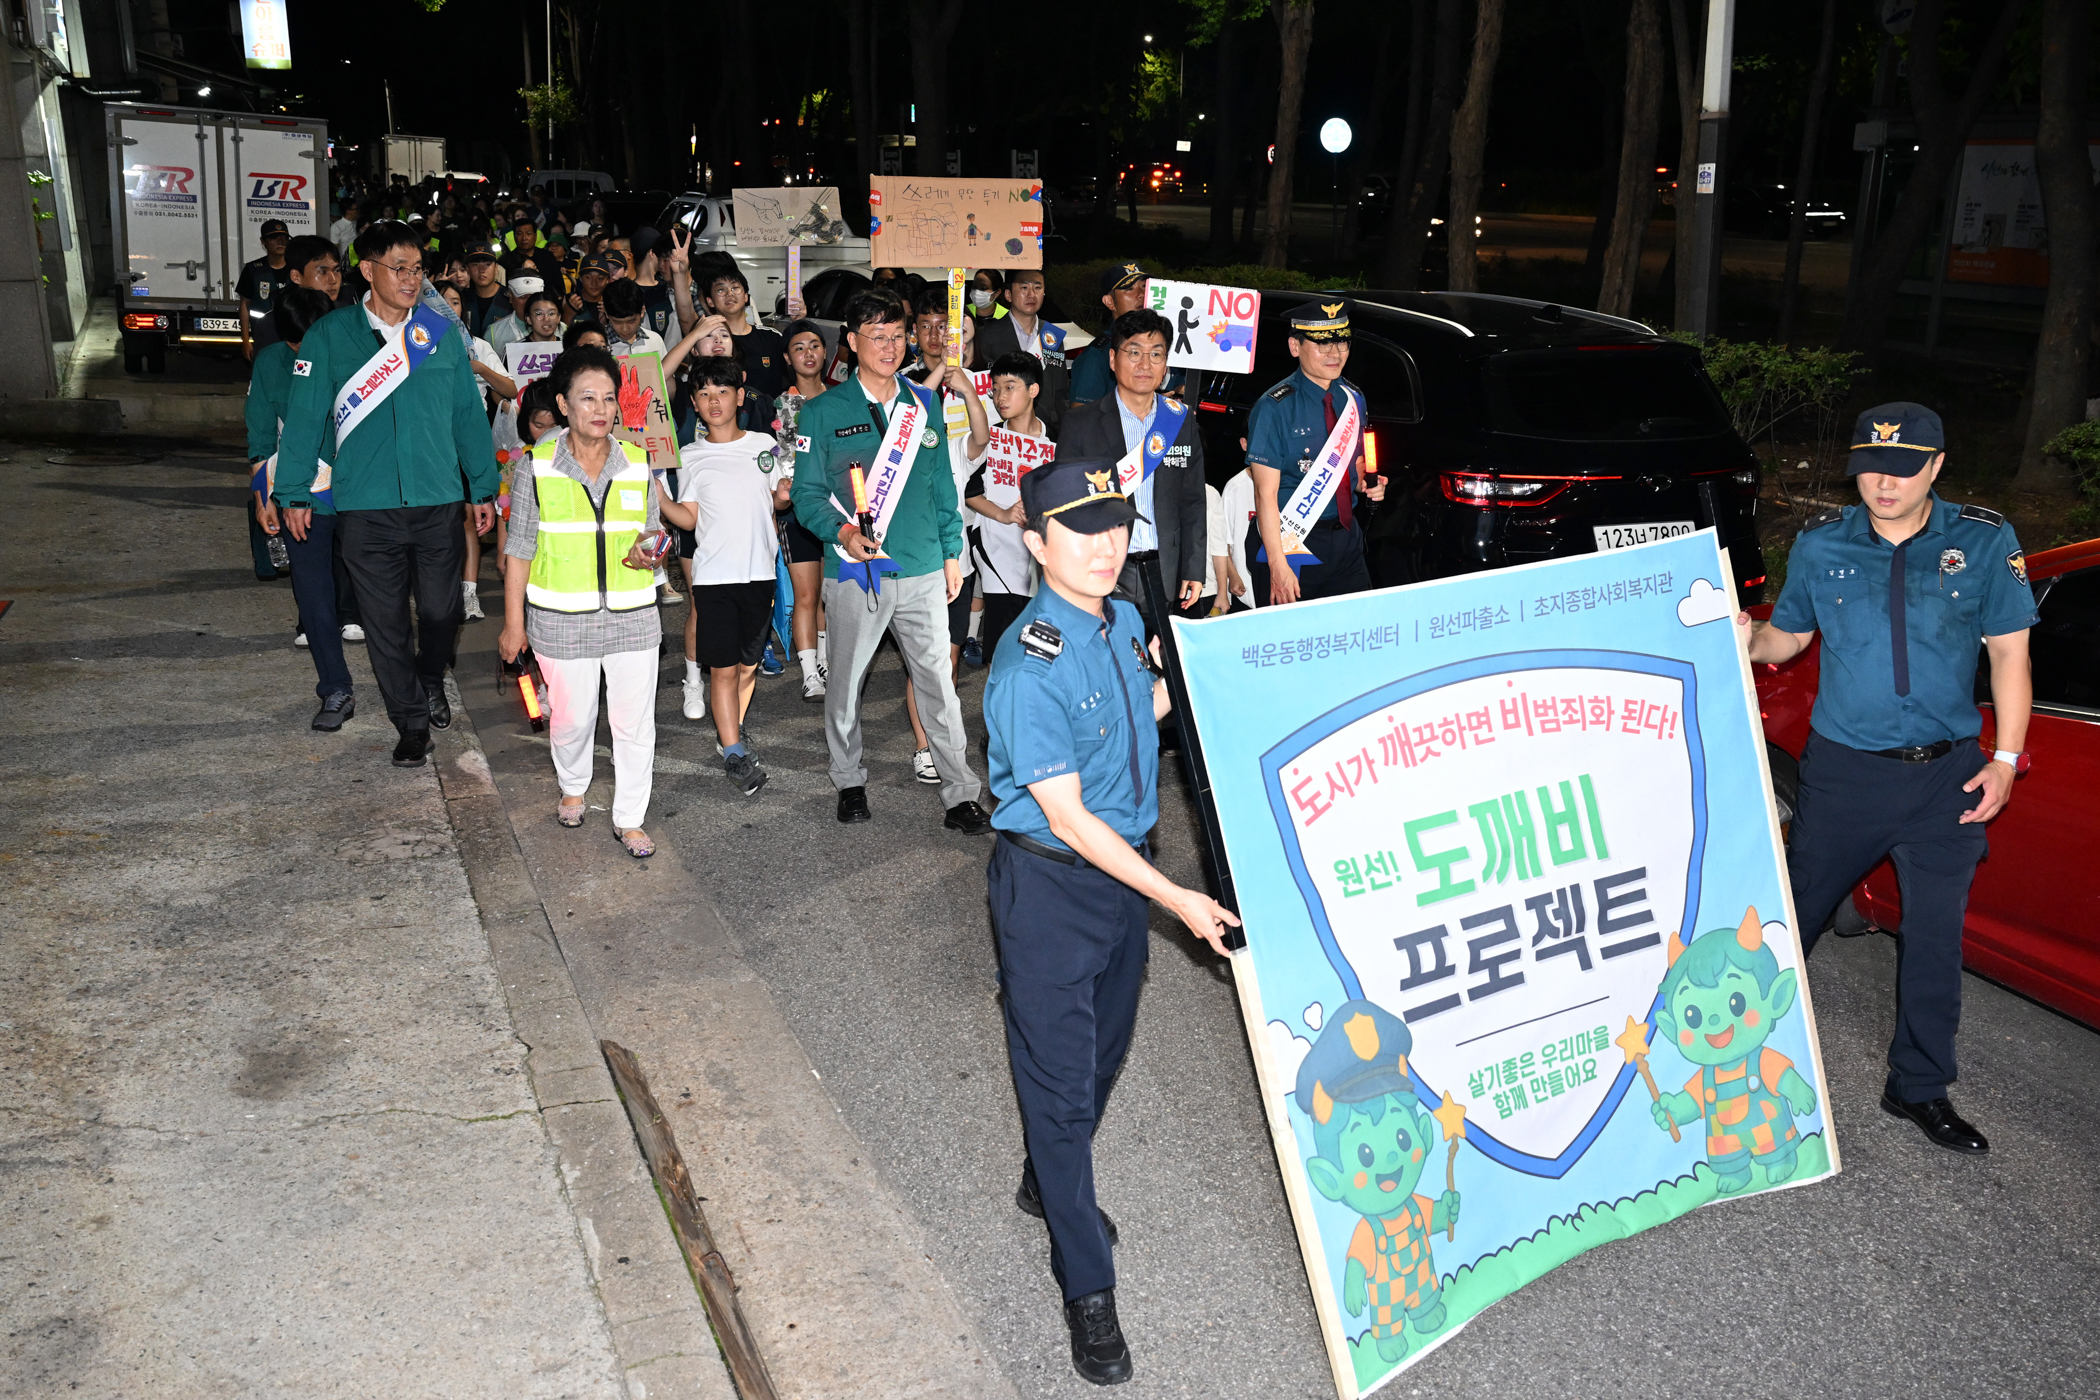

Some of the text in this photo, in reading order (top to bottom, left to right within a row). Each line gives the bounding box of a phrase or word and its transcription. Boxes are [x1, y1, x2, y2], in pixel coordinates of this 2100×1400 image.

[252, 42, 285, 58] 슈퍼
[135, 202, 196, 211] KOREA-INDONESIA
[248, 172, 307, 201] BR
[983, 189, 1000, 206] 투기
[250, 209, 308, 218] KOREA-INDONESIA
[954, 273, 964, 284] 12
[1149, 286, 1256, 320] 걸 NO
[202, 319, 230, 330] 839도
[347, 353, 403, 410] 기초질서를
[868, 404, 919, 523] 기초질서를 지킵시다
[1295, 467, 1333, 519] 지킵시다
[1242, 571, 1674, 668] 백운동행정복지센터 원선파출소 초지종합사회복지관
[1289, 688, 1679, 828] 도시가 깨끗하면 비범죄화 된다!
[1332, 772, 1611, 909] 원선! 도깨비
[1392, 865, 1663, 1025] 프로젝트
[1467, 1025, 1611, 1100] 살기좋은 우리마을
[1492, 1057, 1598, 1120] 함께 만들어요
